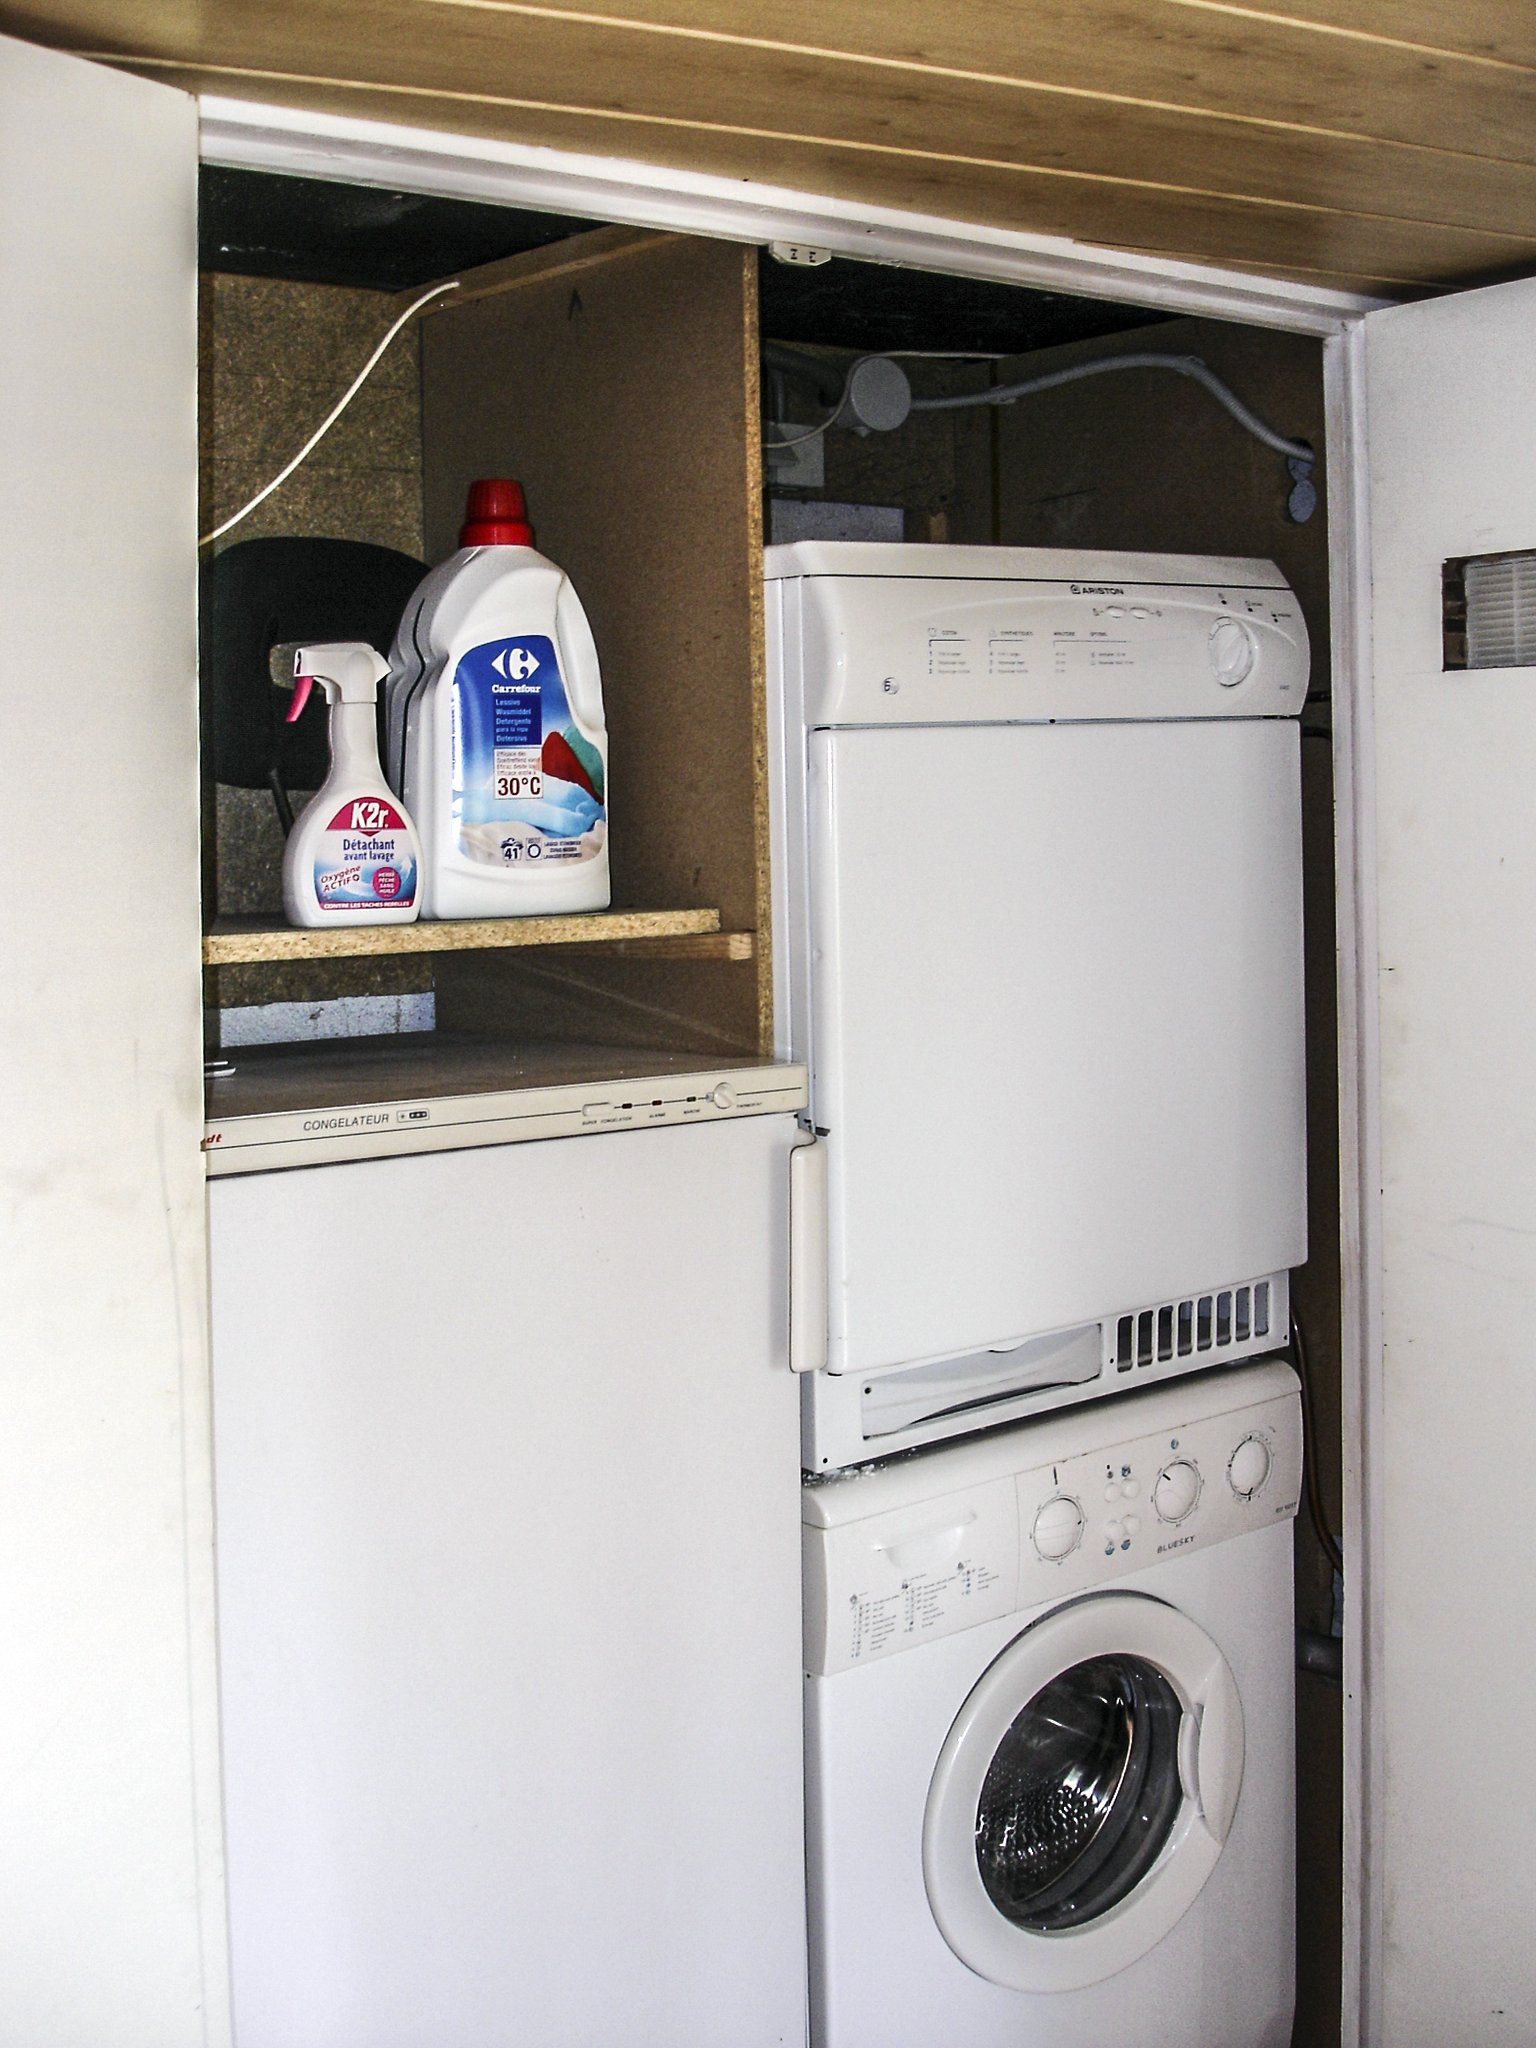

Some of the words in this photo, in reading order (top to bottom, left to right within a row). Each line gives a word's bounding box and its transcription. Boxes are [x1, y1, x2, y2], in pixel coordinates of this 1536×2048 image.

[1082, 587, 1124, 595] ARISTON
[491, 684, 541, 693] Carrefour
[498, 777, 541, 796] 30°C
[343, 837, 395, 850] Détachant
[343, 852, 367, 861] avant
[369, 851, 395, 862] lavage
[504, 848, 518, 860] 41
[320, 865, 361, 884] Oxygène
[323, 876, 351, 892] ACTIF
[303, 1113, 390, 1132] CONGELATEUR
[1157, 1535, 1195, 1554] BLUESKY
